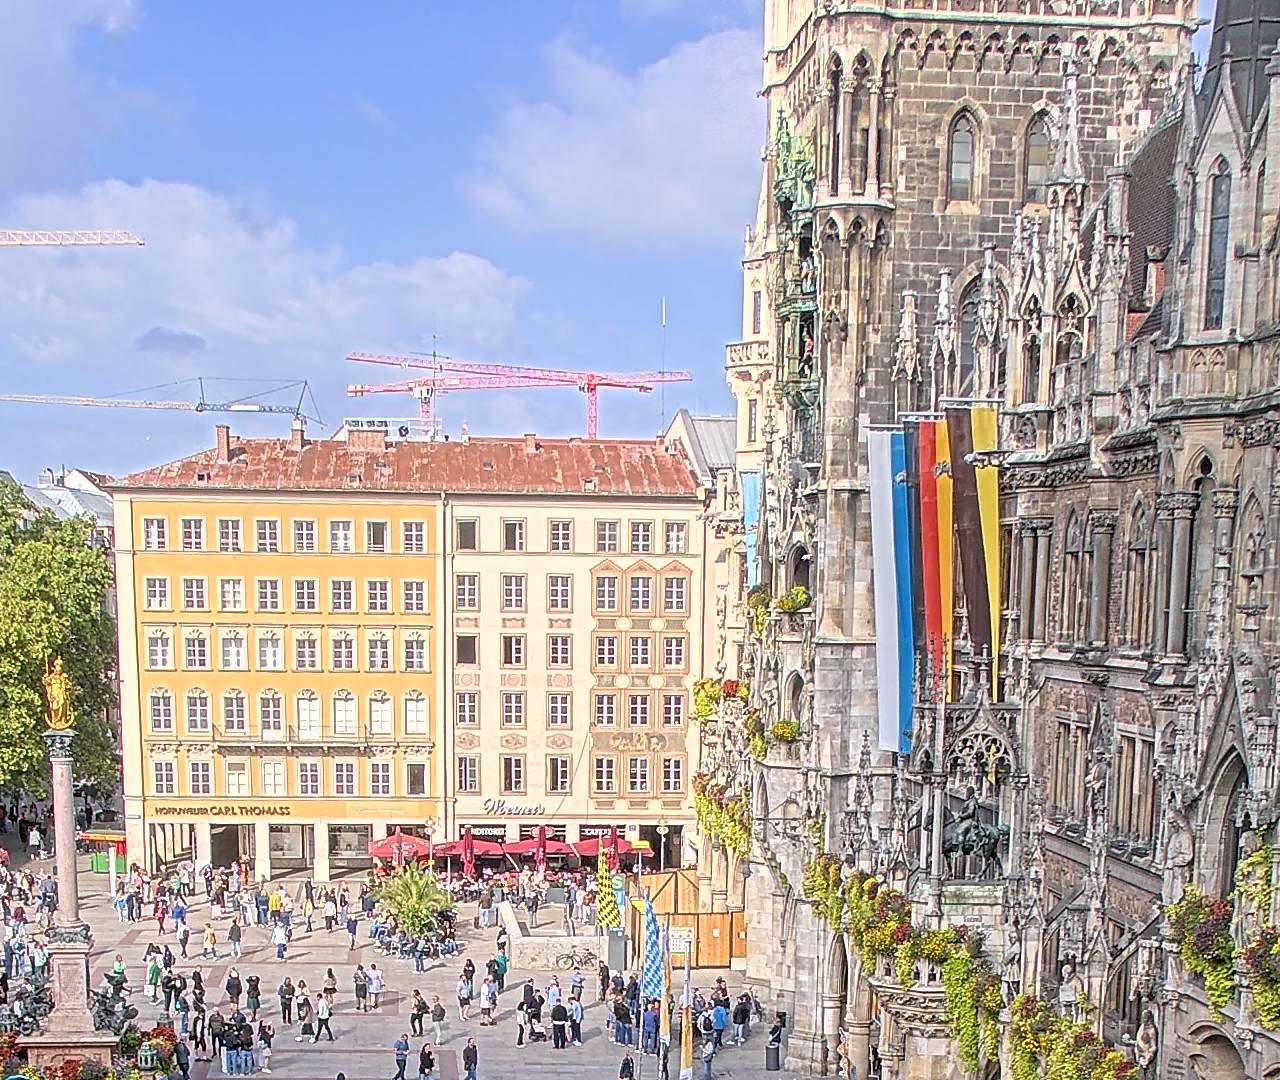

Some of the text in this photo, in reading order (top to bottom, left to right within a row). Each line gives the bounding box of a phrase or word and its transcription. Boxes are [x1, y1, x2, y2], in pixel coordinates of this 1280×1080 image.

[210, 806, 237, 816] CARL
[238, 806, 291, 816] THOMASS
[612, 876, 623, 889] S
